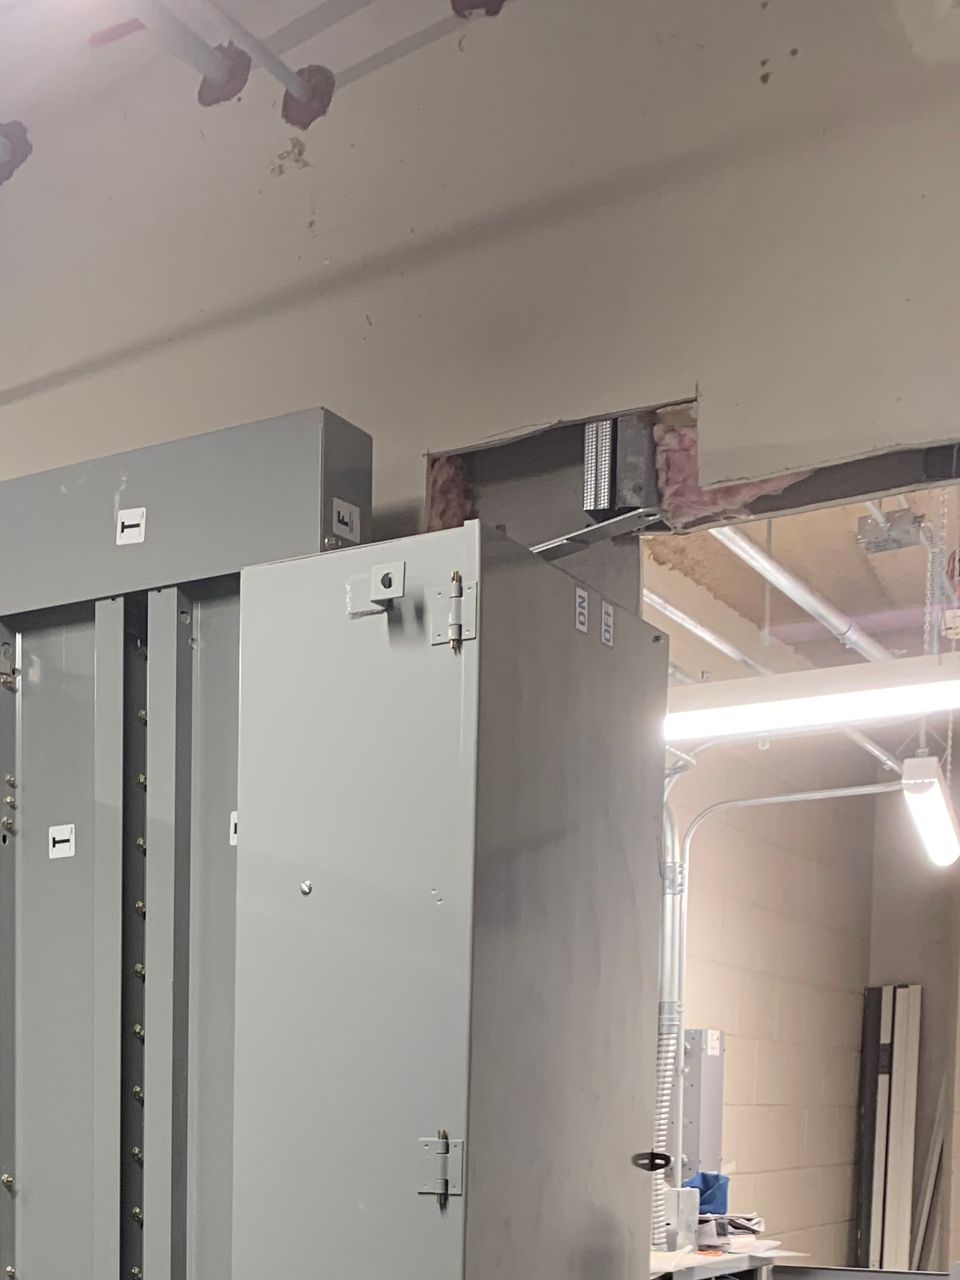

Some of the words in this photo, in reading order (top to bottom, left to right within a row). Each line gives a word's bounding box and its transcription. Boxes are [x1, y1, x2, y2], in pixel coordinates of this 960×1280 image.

[121, 521, 141, 533] T
[337, 510, 349, 527] F
[577, 593, 587, 627] ON
[602, 604, 612, 643] OFF
[52, 837, 70, 848] T
